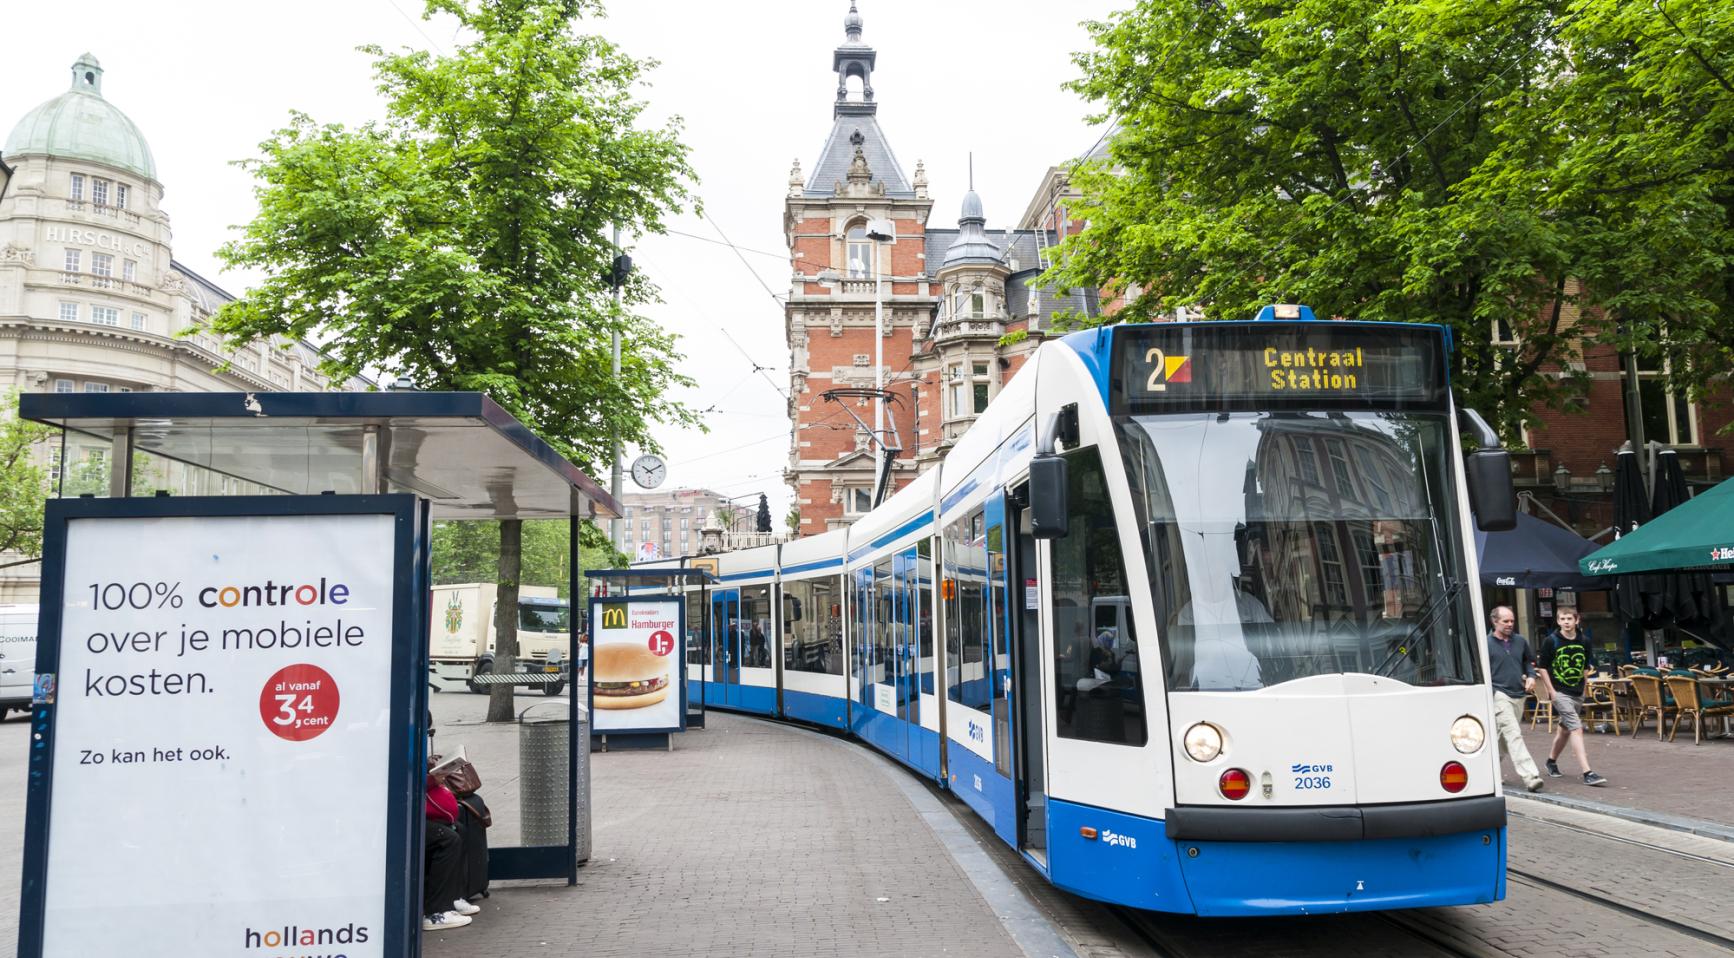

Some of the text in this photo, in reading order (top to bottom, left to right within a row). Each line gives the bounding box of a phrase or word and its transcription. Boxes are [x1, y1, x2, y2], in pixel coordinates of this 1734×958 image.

[46, 226, 121, 252] HIRSCH
[1145, 347, 1363, 391] 2 Centraal
[1271, 370, 1357, 390] Station
[89, 577, 349, 611] 100% controle
[631, 620, 675, 631] Hamburger
[87, 619, 364, 657] over je mobiele
[85, 668, 214, 697] kosten.
[275, 680, 321, 691] al vanaf
[303, 716, 329, 726] cent
[80, 745, 230, 765] Zo kan het ook.
[1311, 764, 1333, 773] GVB
[1294, 776, 1331, 790] 2036
[1118, 834, 1137, 849] GVB
[245, 922, 369, 948] hollands
